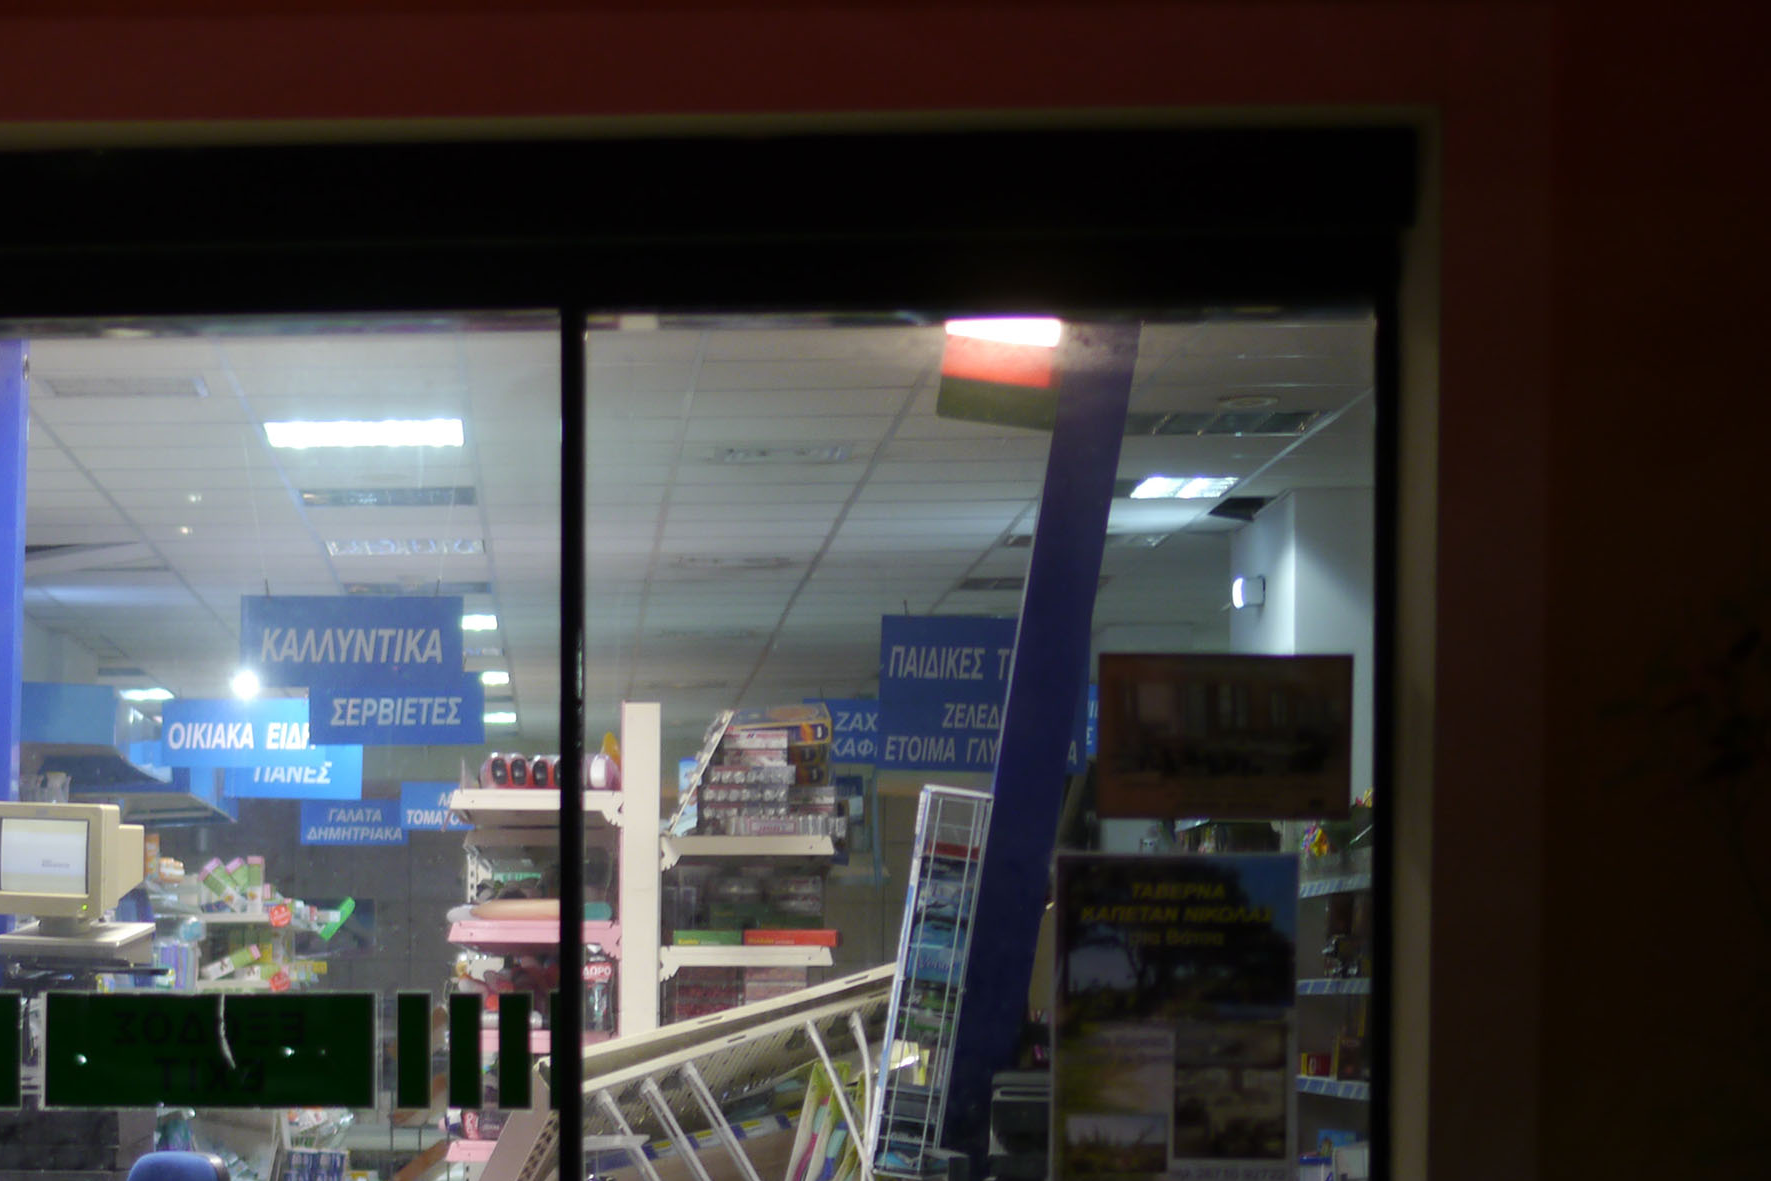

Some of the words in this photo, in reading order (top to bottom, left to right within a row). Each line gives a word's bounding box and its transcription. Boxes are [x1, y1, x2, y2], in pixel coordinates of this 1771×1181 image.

[261, 627, 443, 664] ΚΑΛΛΥΝΤΙΚΑ
[888, 645, 987, 680] ΠΑΙΔΙΚΕΣ
[330, 696, 462, 727] ΣΕΡΒΙΕΤΕΣ
[168, 721, 254, 750] ΟΙΚΙΑΚΑ
[884, 735, 957, 762] ΕΤΟΙΜΑ
[327, 808, 383, 823] ΓΑΛΑΤΑ
[306, 825, 403, 841] ΔΗΜΗΤΡΙΑΚΑ
[1131, 881, 1226, 900] ΤΑΒΕΡΝΑ
[1079, 904, 1179, 923] ΚΑΠΕΤΑΝ
[1183, 904, 1274, 923] ΝΙΚΟΛΑΣ
